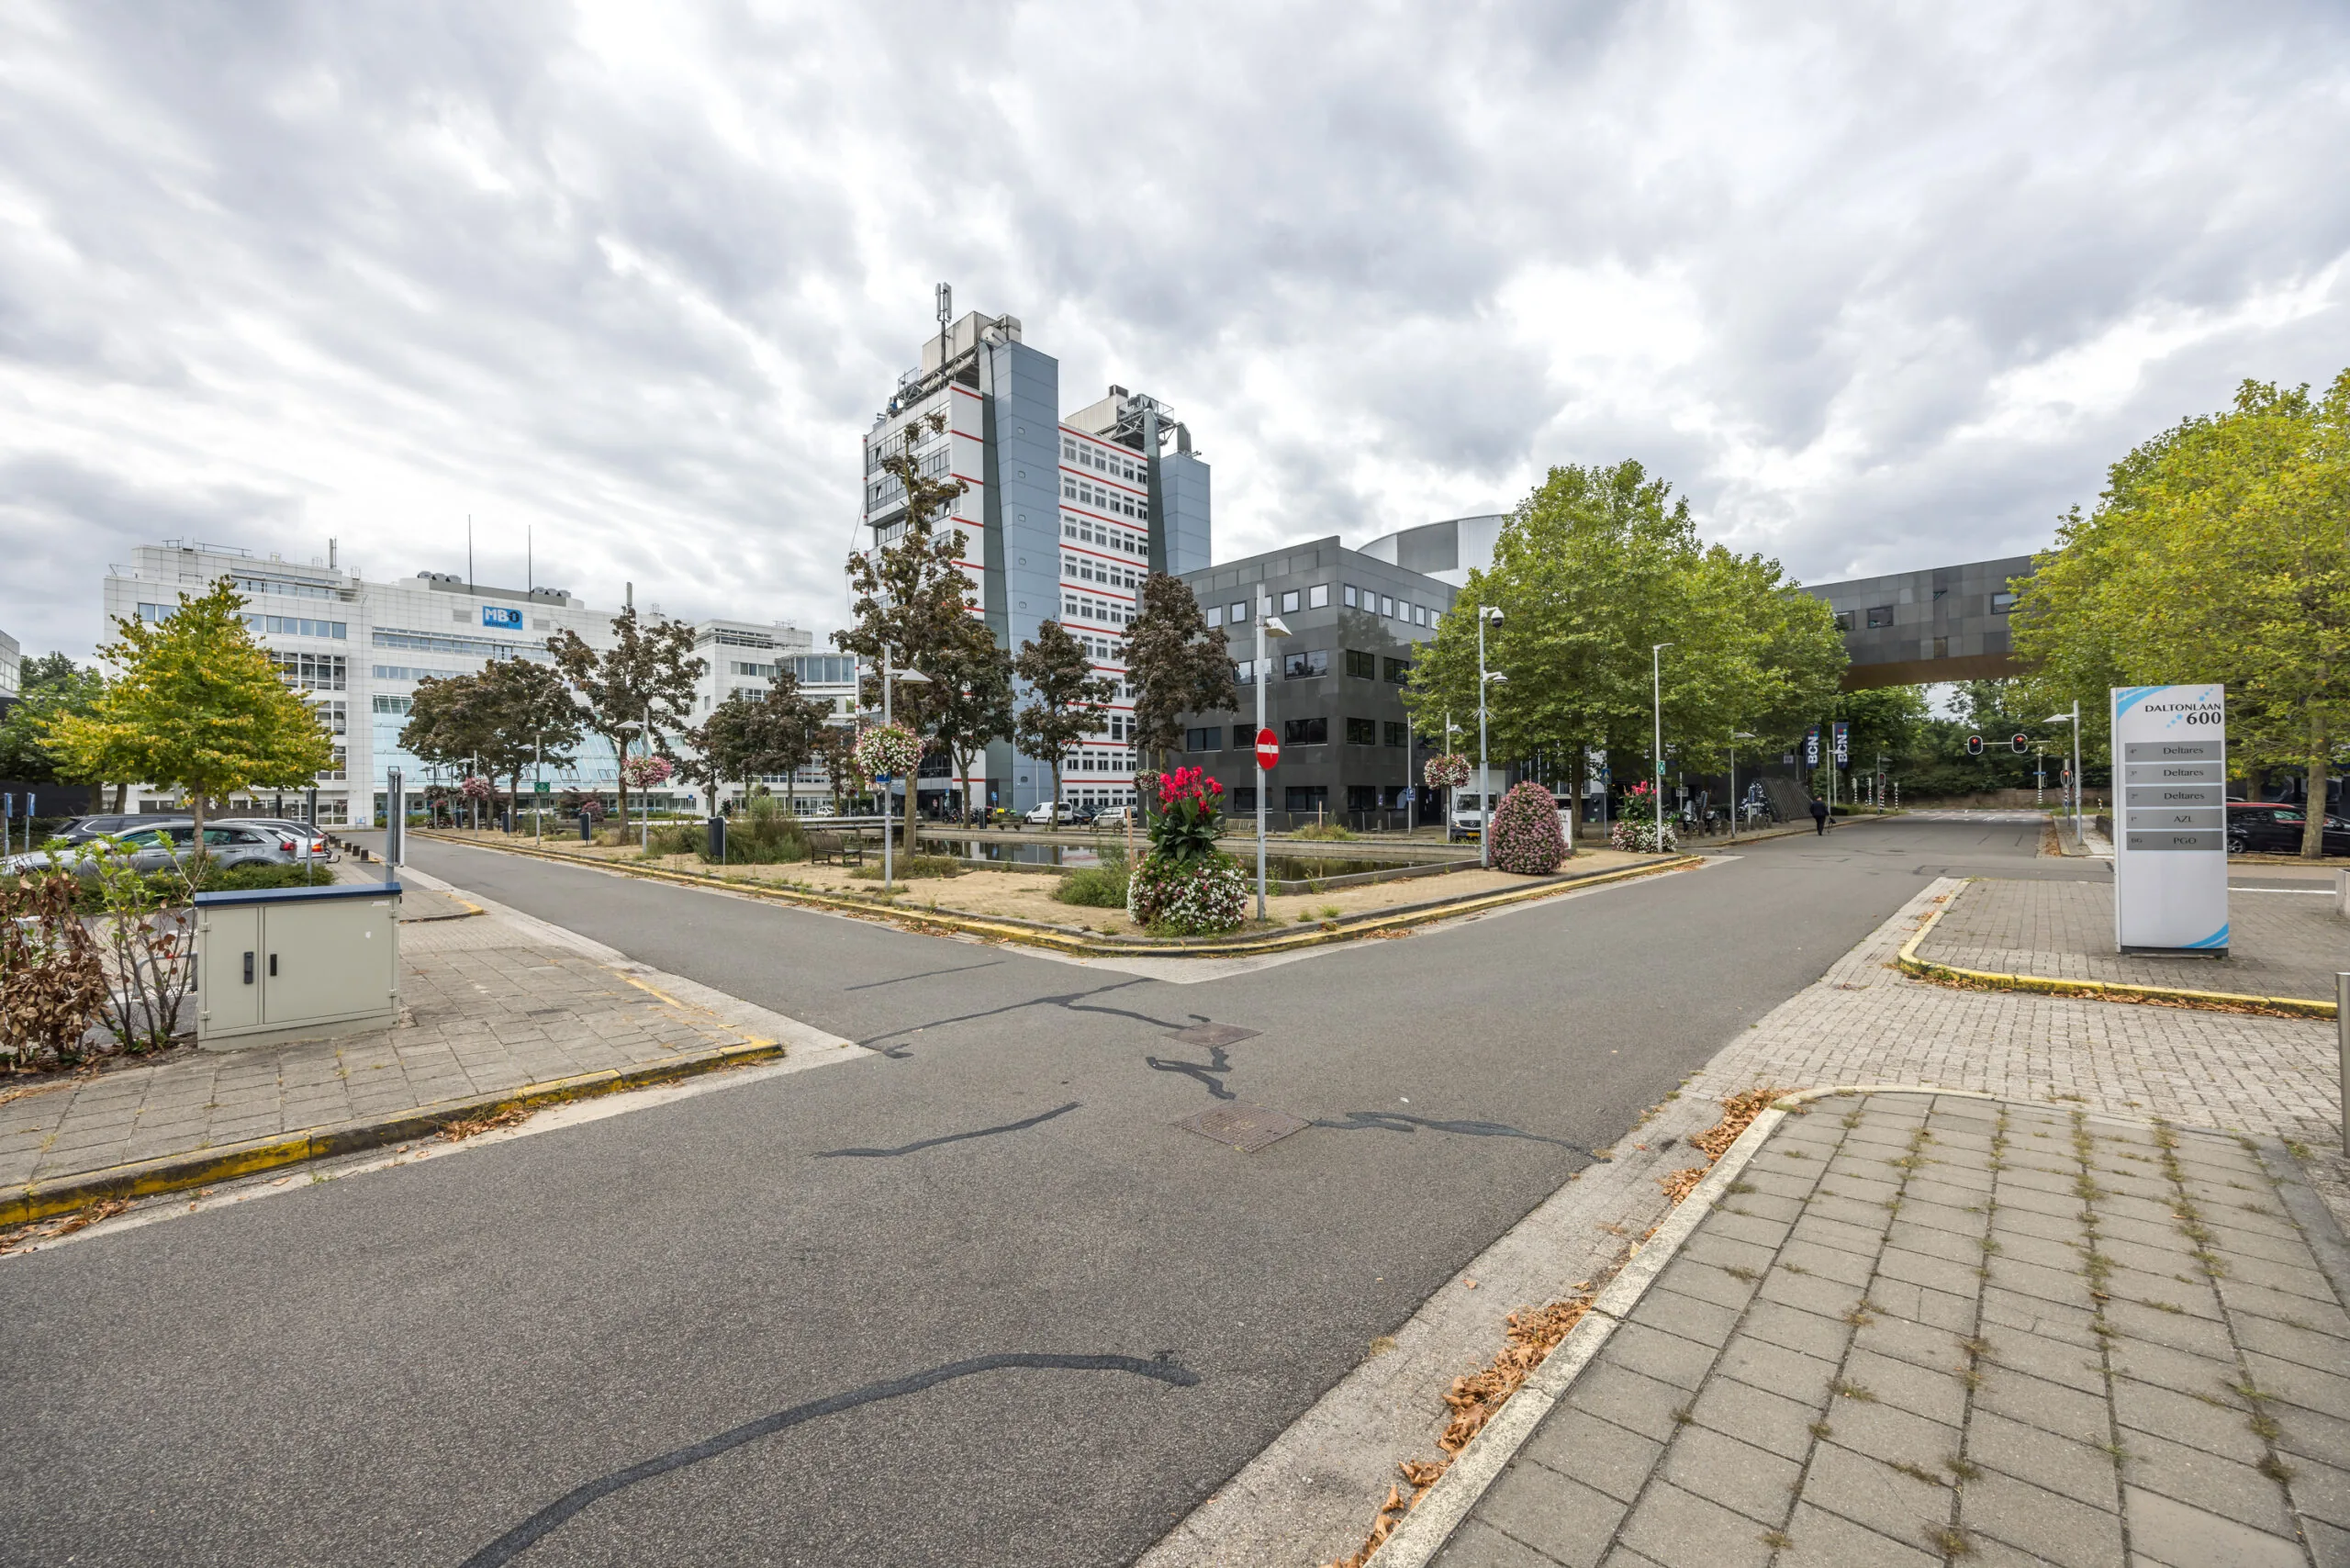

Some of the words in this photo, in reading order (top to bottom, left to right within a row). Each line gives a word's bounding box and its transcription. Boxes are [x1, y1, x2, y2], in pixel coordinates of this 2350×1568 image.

[485, 609, 520, 623] MBO
[2144, 703, 2221, 712] DALTONLAAN
[2186, 711, 2221, 725] 600
[1807, 736, 1818, 764] BCN
[1837, 734, 1848, 763] BCN
[2163, 745, 2204, 755] Deltares
[2163, 768, 2204, 777] Deltares
[2164, 791, 2205, 800] Deltares
[2173, 836, 2197, 845] PGO
